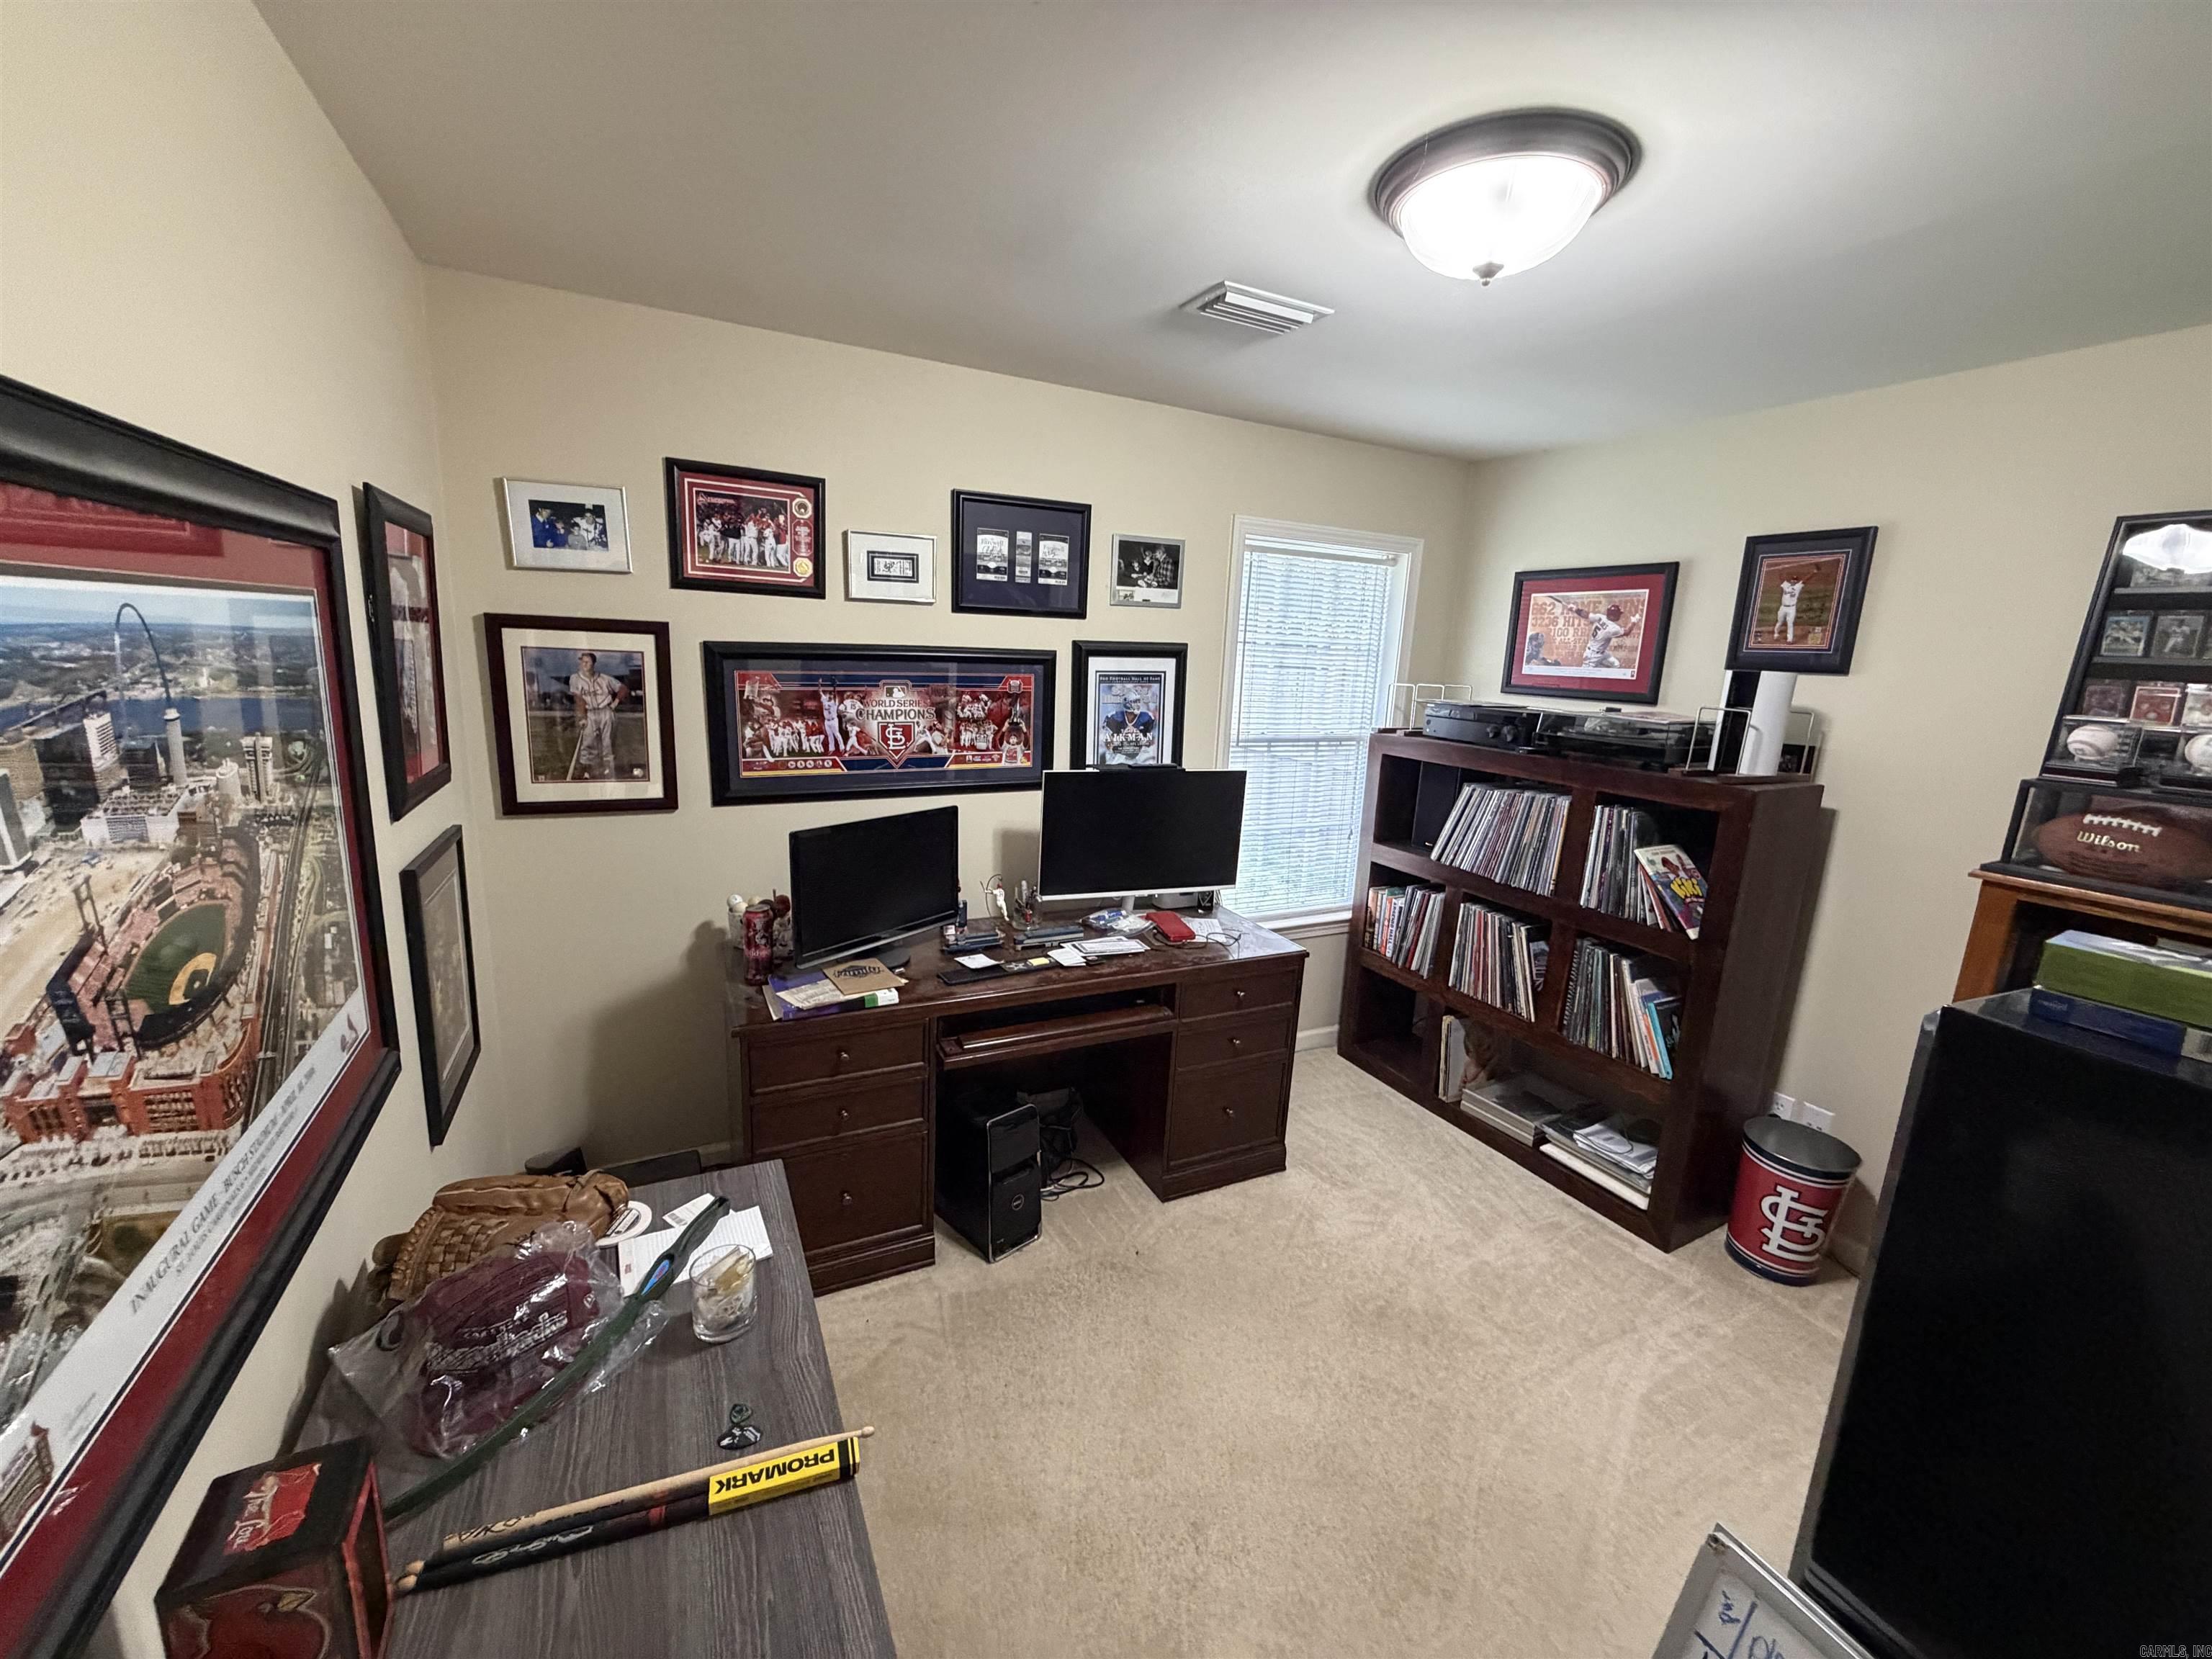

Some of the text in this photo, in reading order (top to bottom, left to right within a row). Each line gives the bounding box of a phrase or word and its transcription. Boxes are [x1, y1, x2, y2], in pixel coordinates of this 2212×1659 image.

[865, 699, 895, 708] WORLD
[855, 706, 935, 721] CHAMPIONS
[1103, 733, 1153, 742] AIKMAN
[2077, 831, 2140, 853] Wilson
[191, 1192, 220, 1233] GAME
[714, 1449, 835, 1495] PROMARK
